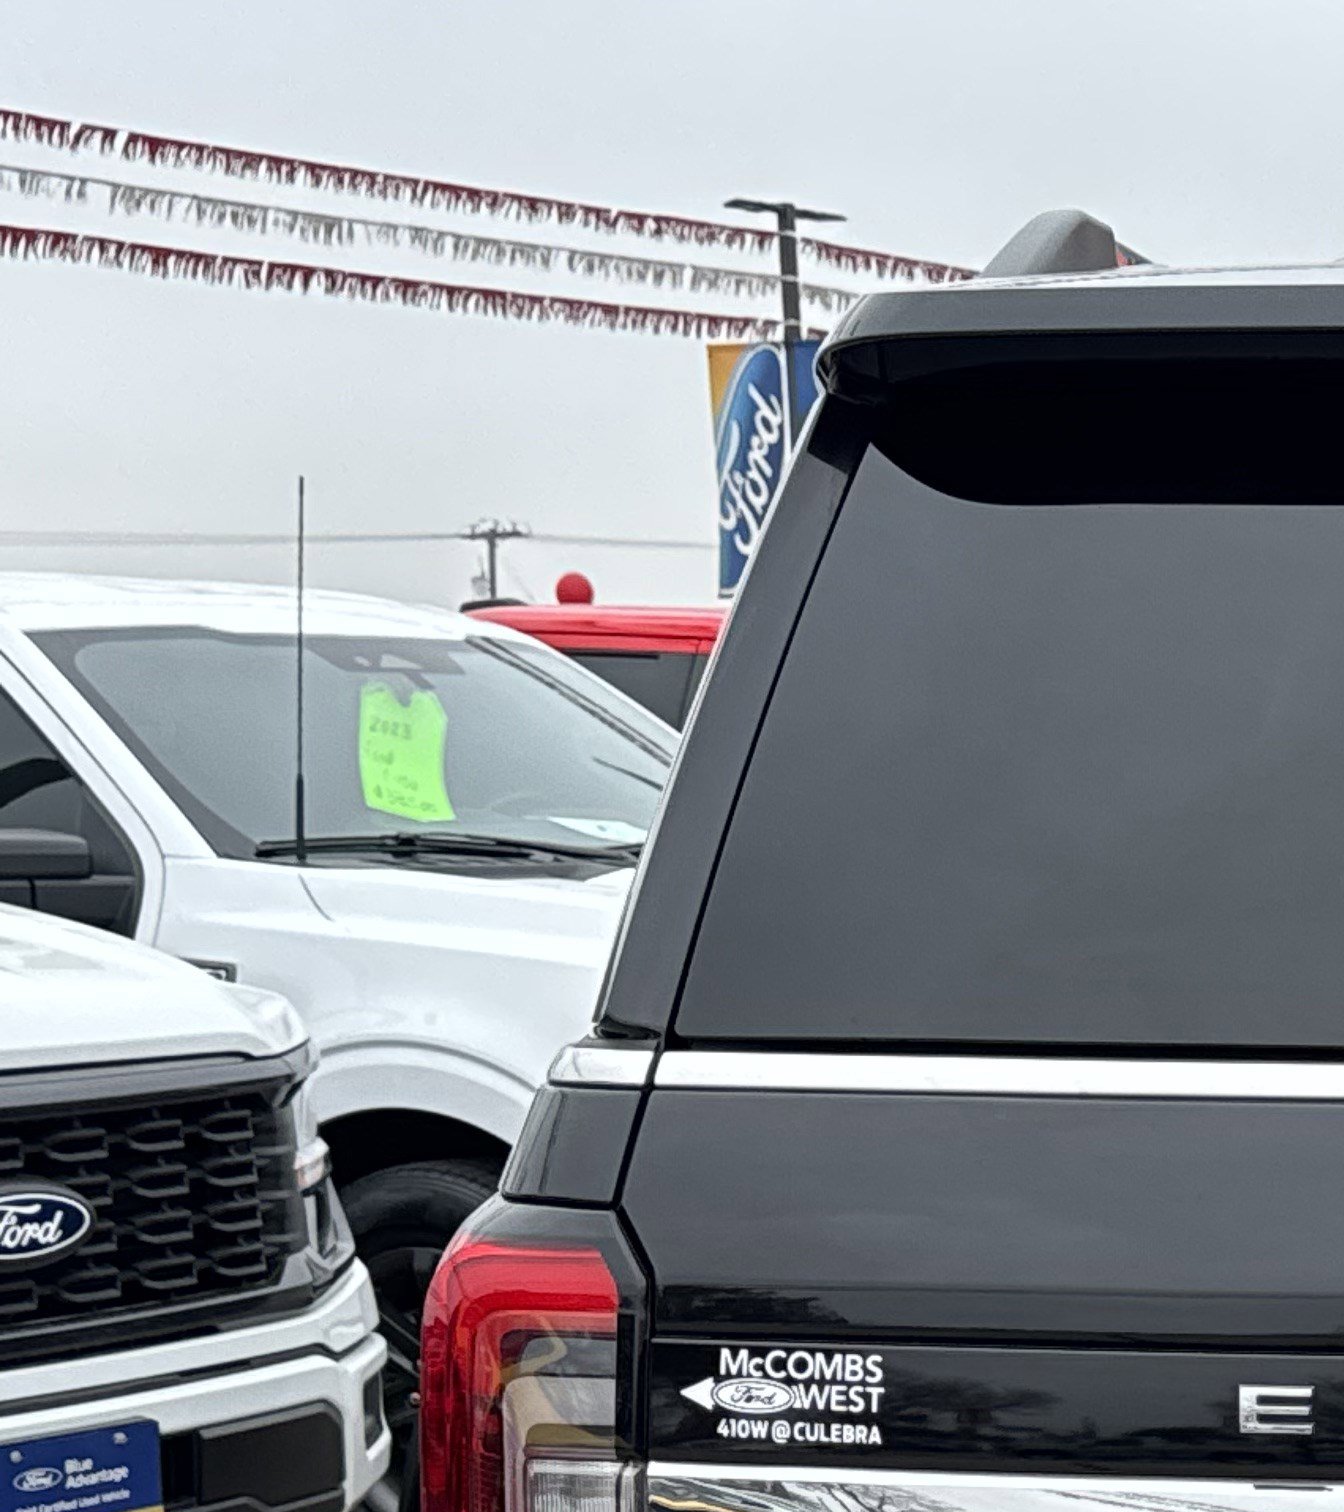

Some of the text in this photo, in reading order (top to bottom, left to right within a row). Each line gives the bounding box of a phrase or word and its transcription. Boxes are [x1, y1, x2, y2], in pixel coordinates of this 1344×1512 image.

[719, 382, 784, 556] Ford
[719, 1347, 884, 1384] McCOMBS
[730, 1383, 886, 1414] Ford WEST
[793, 1421, 882, 1445] CULEBRA
